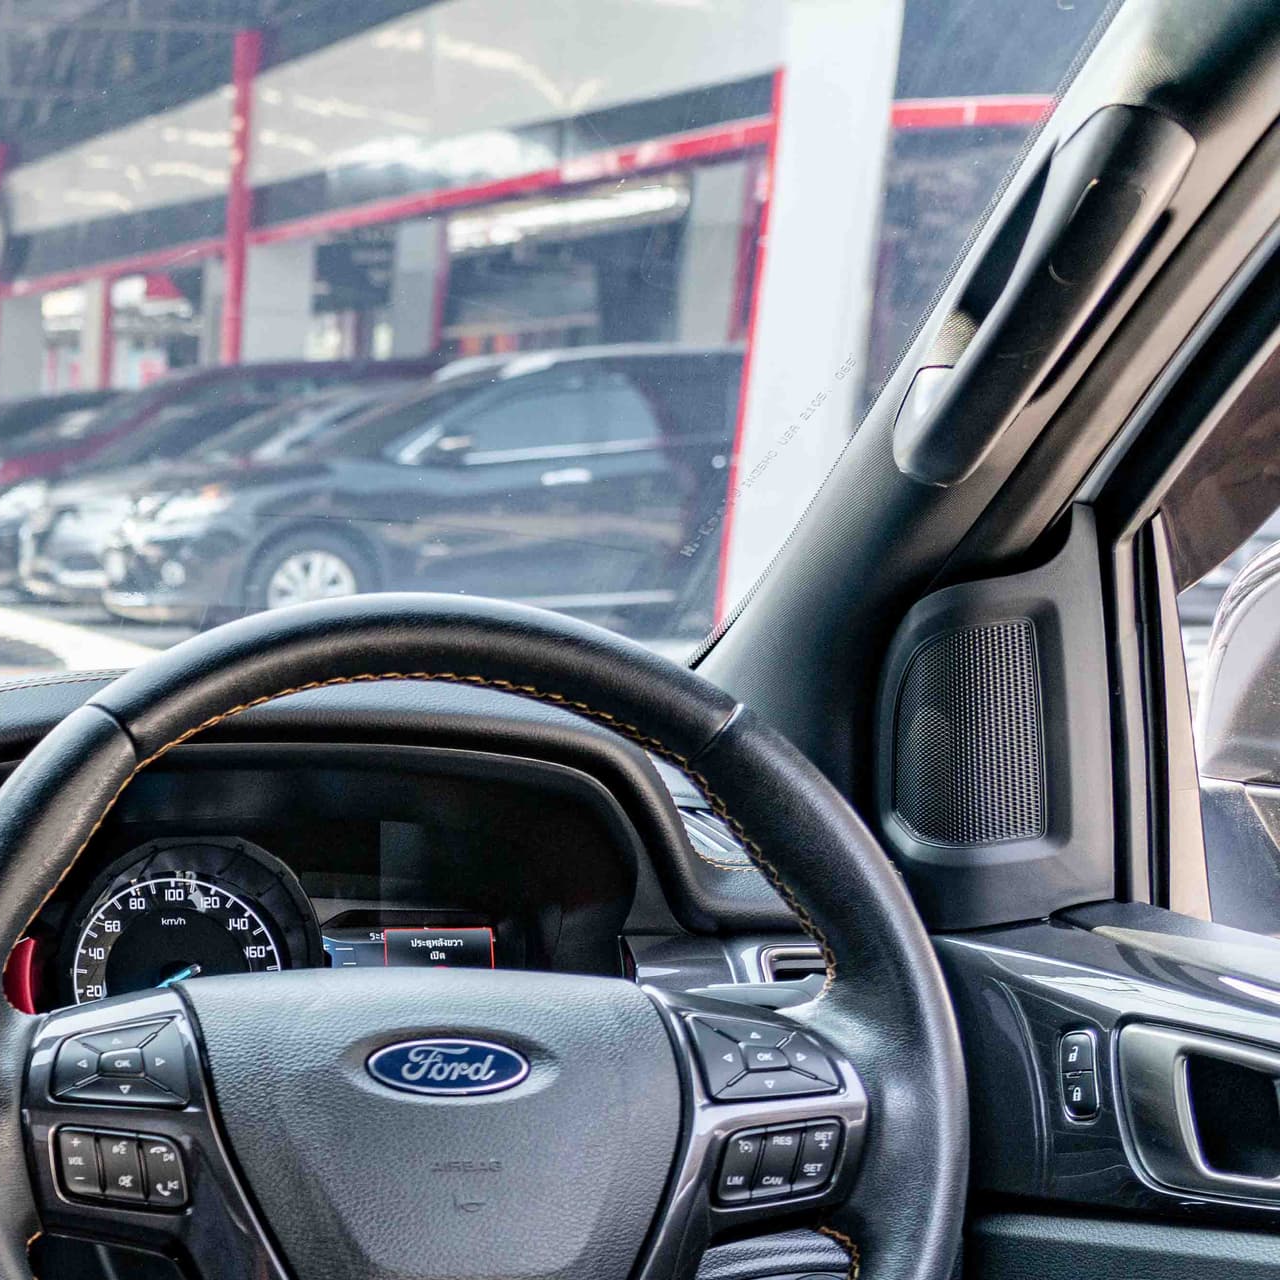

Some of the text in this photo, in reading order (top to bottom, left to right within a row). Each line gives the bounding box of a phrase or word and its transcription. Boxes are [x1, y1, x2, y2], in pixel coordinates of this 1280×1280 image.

[164, 888, 184, 902] 100
[129, 897, 146, 910] 80
[200, 896, 220, 909] 120
[104, 920, 121, 933] 60
[161, 917, 186, 926] km/h
[227, 918, 249, 931] 140
[88, 947, 105, 960] 40
[86, 985, 102, 998] 20
[756, 1052, 773, 1061] OK
[114, 1059, 131, 1068] OK
[401, 1046, 497, 1081] Ford
[772, 1136, 793, 1146] RES
[814, 1131, 834, 1141] SET
[431, 1160, 503, 1173] AIRBAG
[803, 1163, 824, 1172] SET
[726, 1176, 744, 1185] LIM
[762, 1176, 784, 1185] CAN
